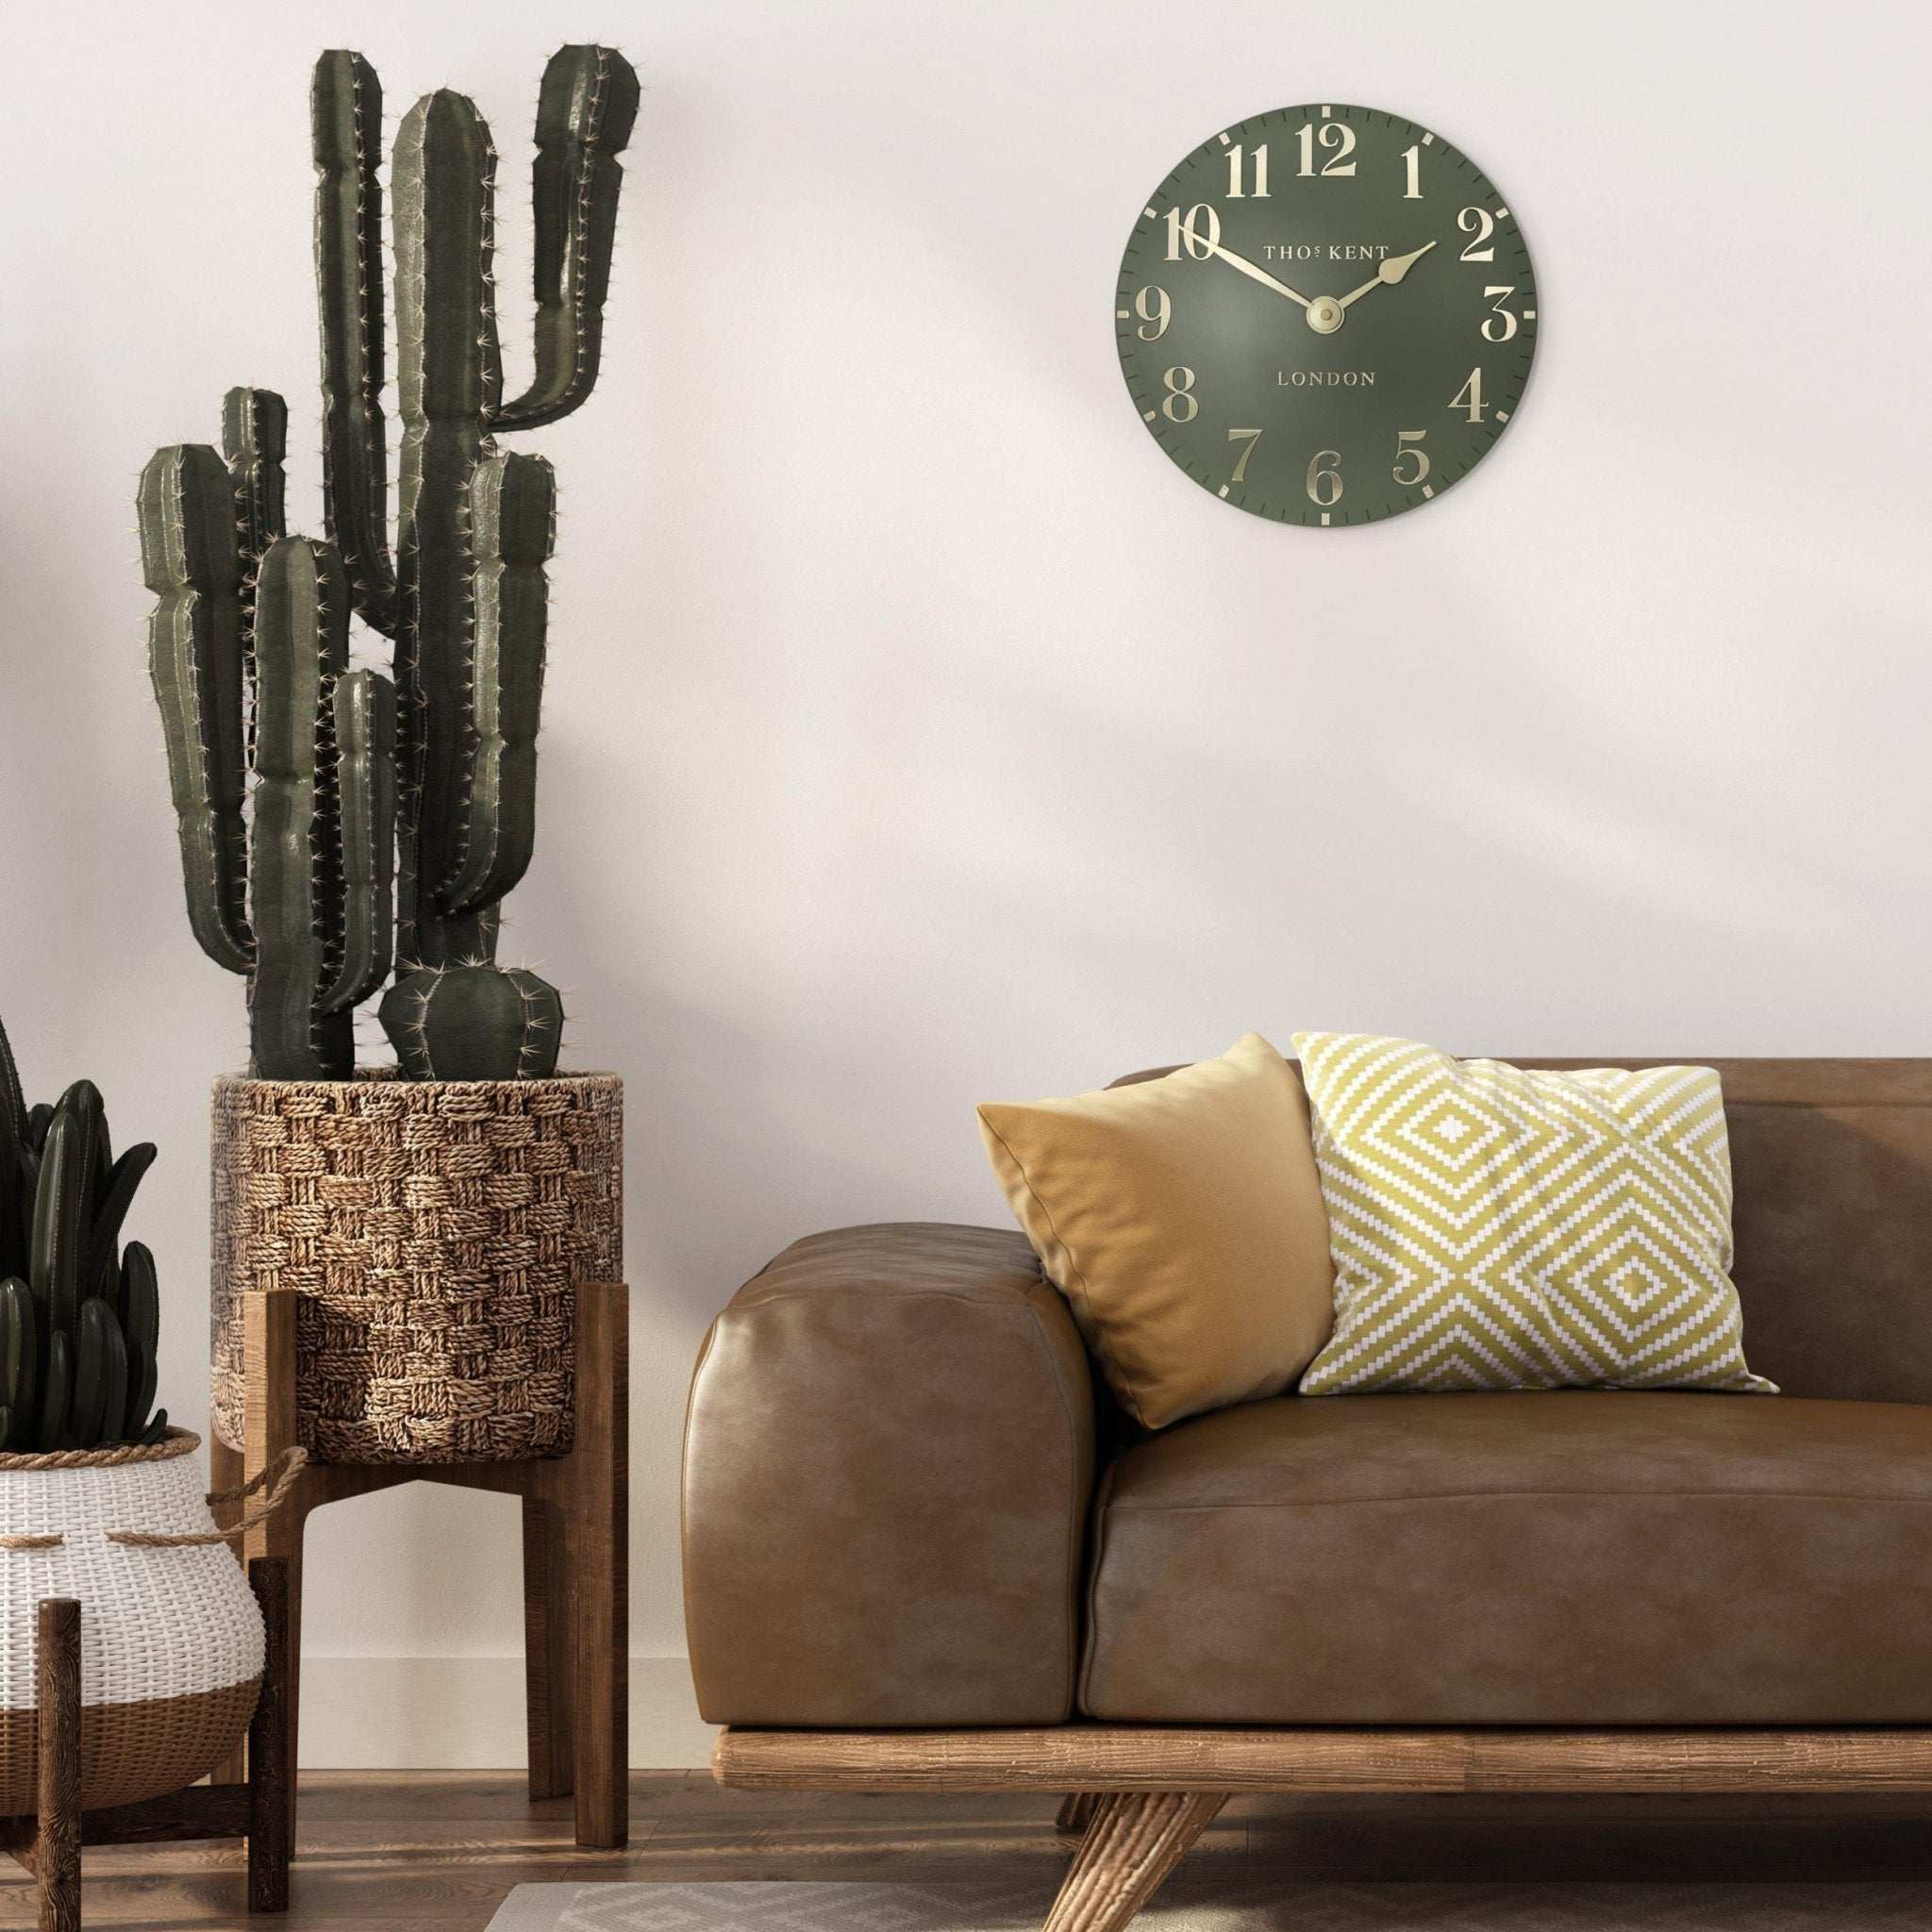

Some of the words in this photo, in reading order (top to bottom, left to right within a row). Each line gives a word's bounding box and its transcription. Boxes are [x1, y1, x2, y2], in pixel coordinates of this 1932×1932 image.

[1224, 143, 1272, 198] 11
[1294, 123, 1357, 177] 12
[1400, 144, 1424, 199] 1
[1162, 203, 1221, 261] 10
[1329, 244, 1390, 260] KENT
[1457, 207, 1495, 262] 2
[1135, 285, 1172, 341] 9
[1480, 286, 1518, 342] 3
[1161, 366, 1199, 423] 8
[1276, 372, 1375, 387] LONDON
[1447, 367, 1490, 424] 4
[1227, 428, 1264, 482] 7
[1306, 449, 1344, 506] 6
[1392, 428, 1430, 485] 5
